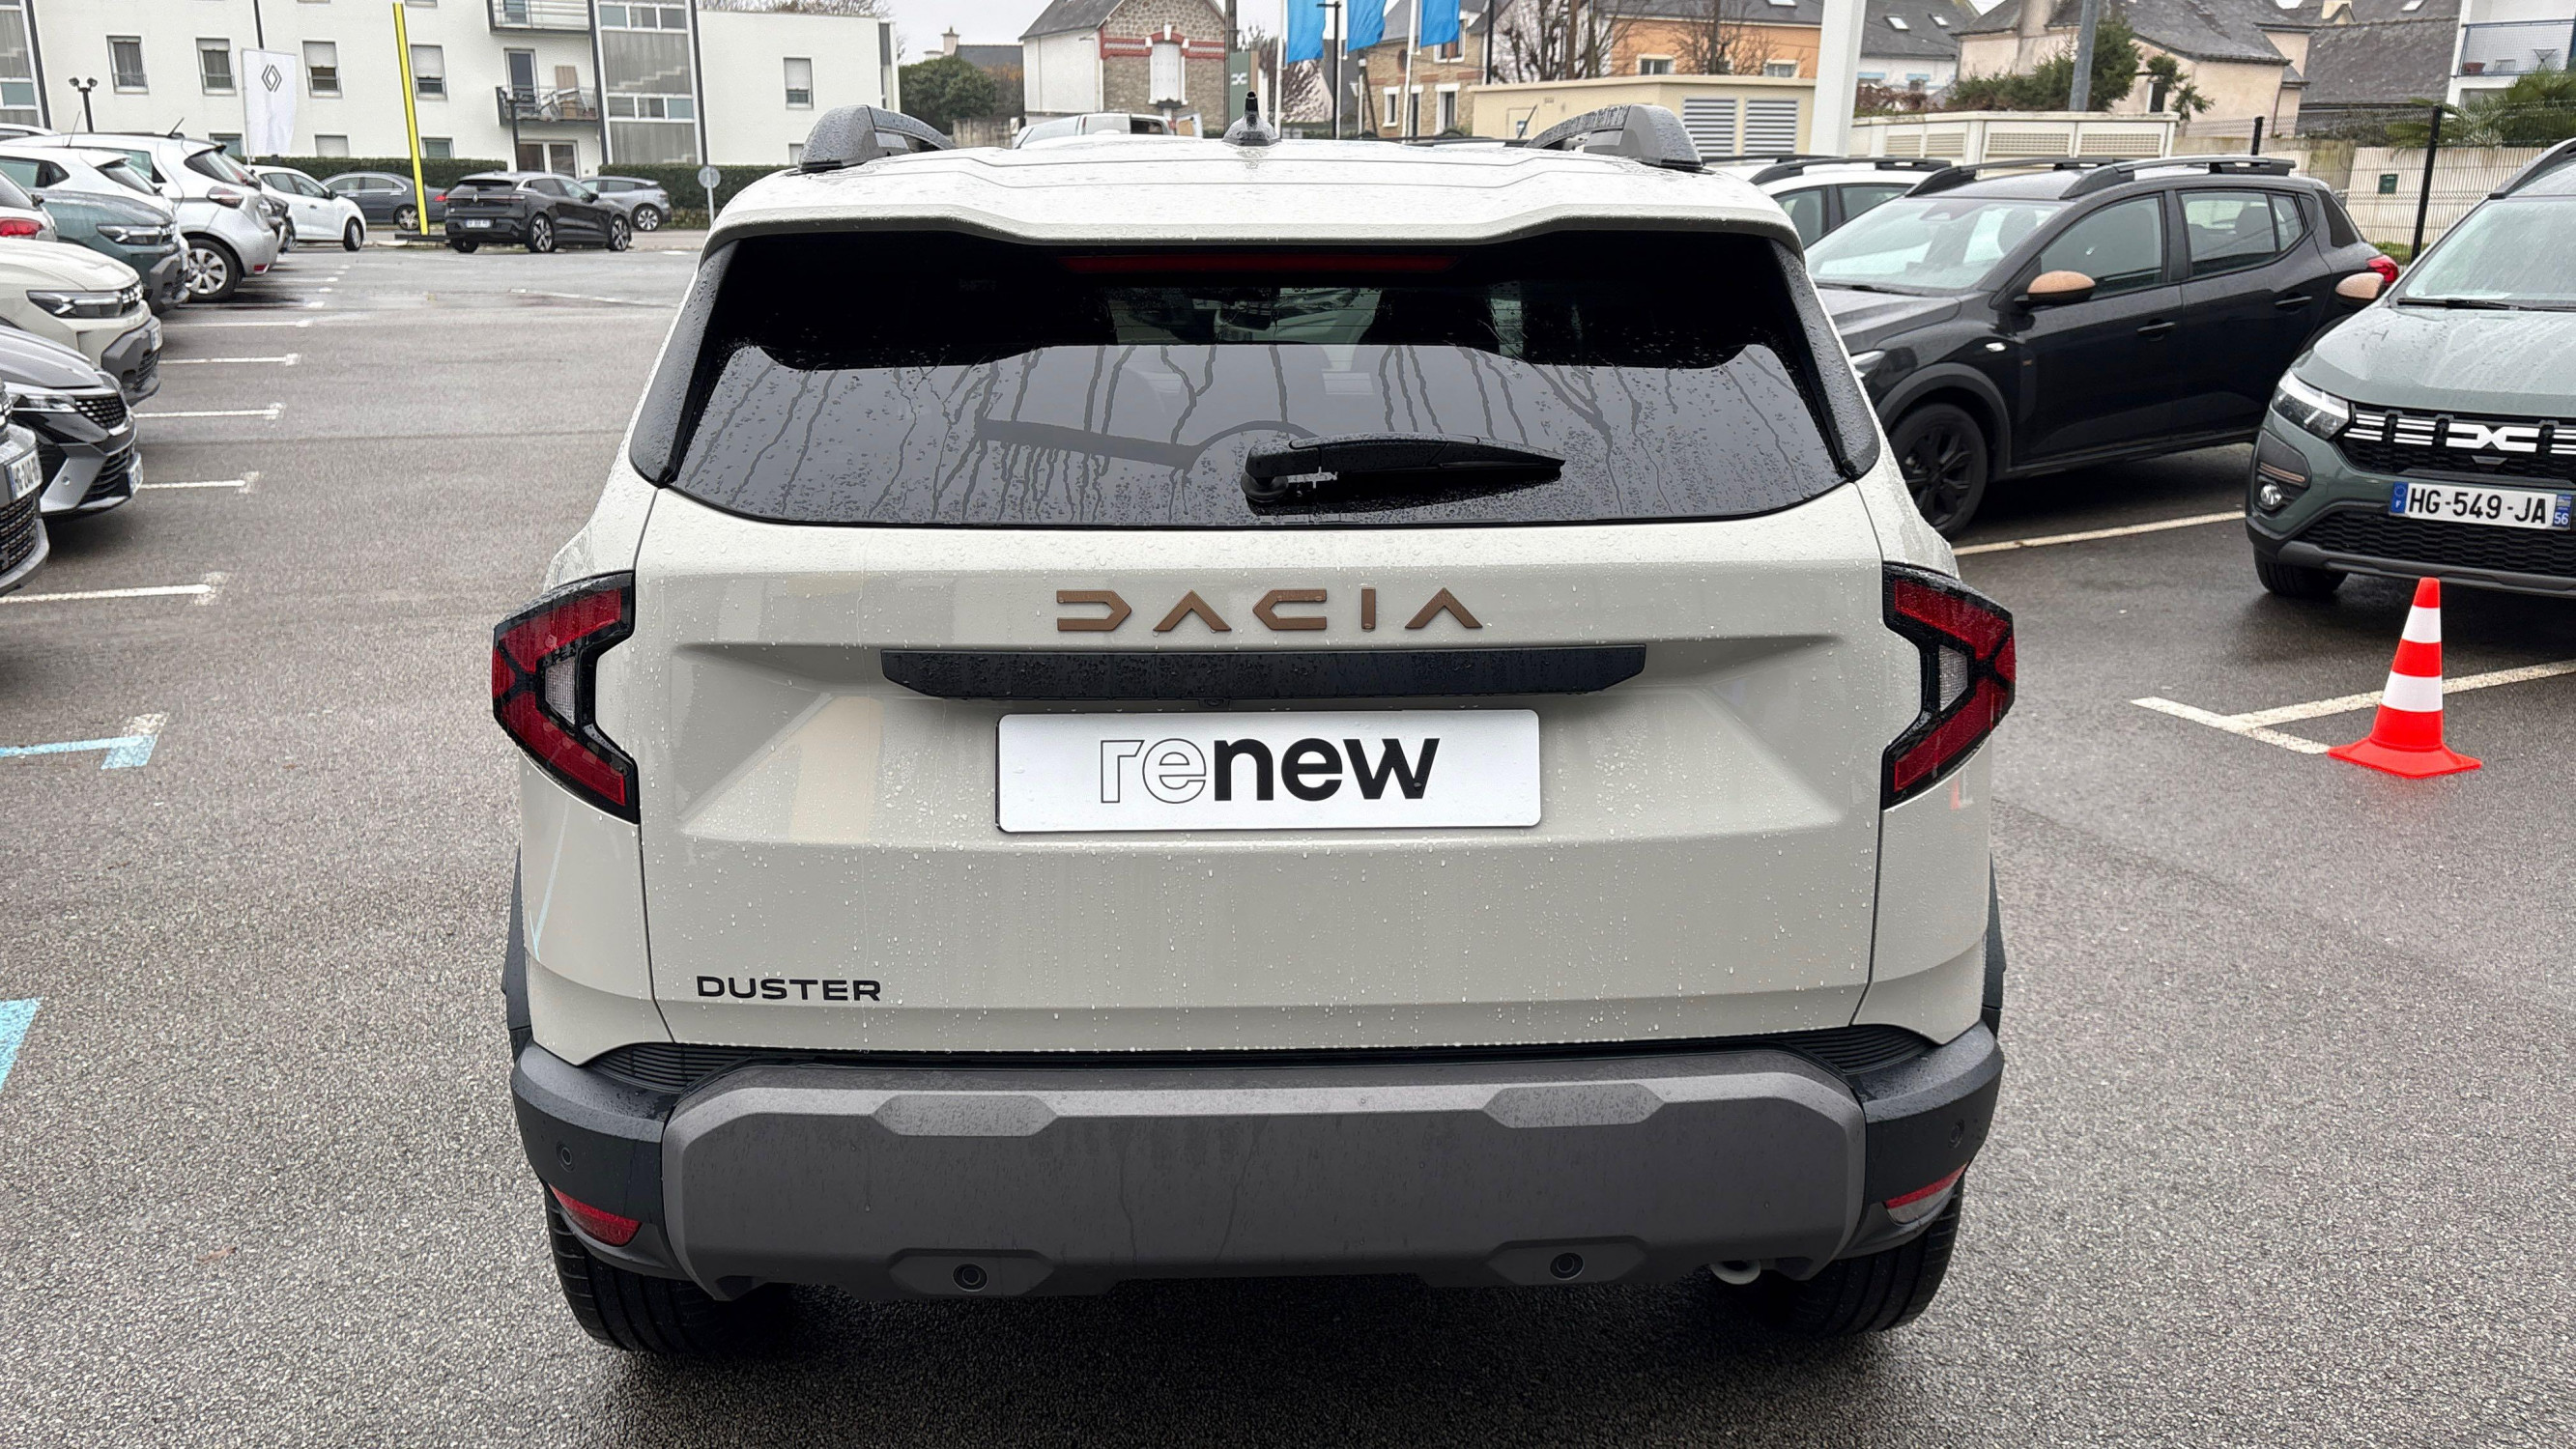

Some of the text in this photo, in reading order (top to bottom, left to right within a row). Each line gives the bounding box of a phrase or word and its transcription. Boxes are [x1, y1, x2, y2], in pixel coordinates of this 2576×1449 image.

[2394, 488, 2570, 526] F HG-549-JA 56
[1056, 586, 1484, 633] DACIA
[1100, 737, 1441, 805] renew
[696, 975, 881, 1002] DUSTER
